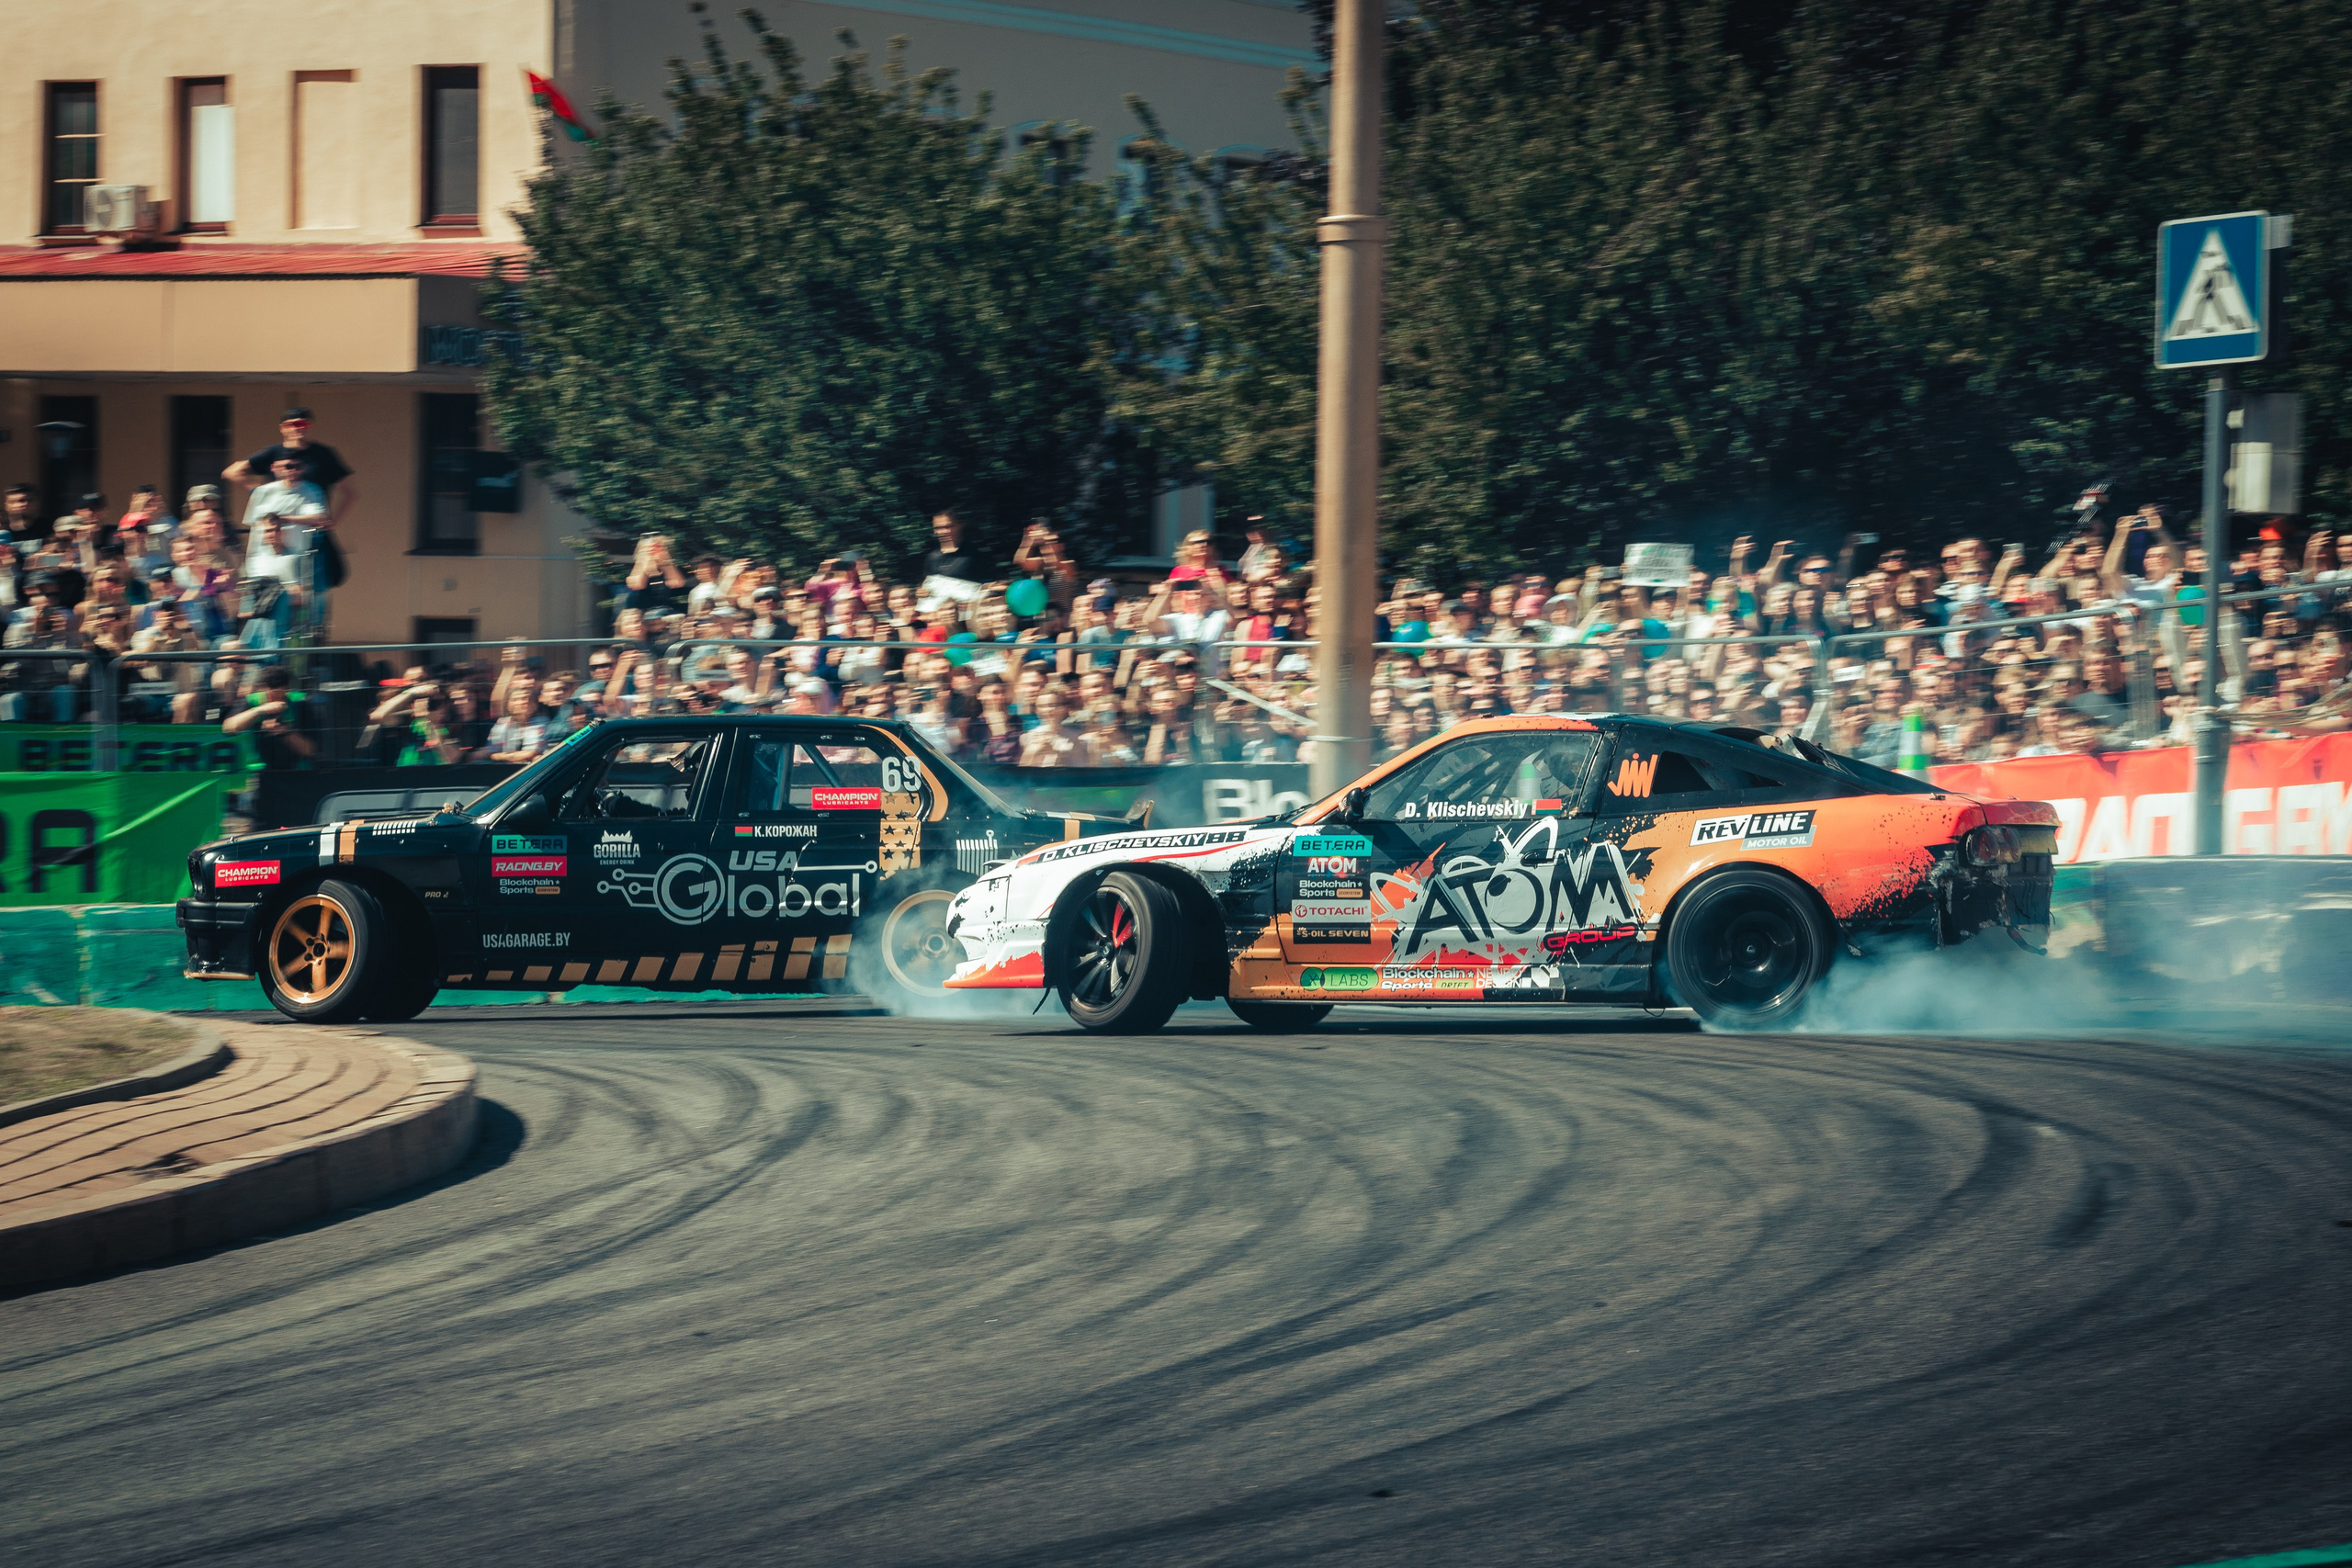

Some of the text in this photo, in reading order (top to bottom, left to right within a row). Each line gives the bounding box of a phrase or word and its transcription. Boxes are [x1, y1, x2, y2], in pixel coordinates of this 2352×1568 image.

[882, 755, 922, 793] 69
[814, 793, 878, 802] CHAMPION
[1405, 800, 1528, 818] D. Klischevskiy
[1062, 832, 1205, 859] KLISCHEVSKIY
[1747, 835, 1808, 849] MOTOR OIL
[594, 843, 641, 858] GORILLA
[495, 862, 563, 872] RACING.BY
[729, 850, 797, 872] USA
[1307, 857, 1357, 874] ATOM
[218, 866, 278, 878] CHAMPION
[499, 878, 554, 886] Blockchain
[1299, 879, 1357, 889] Blockchain
[499, 886, 534, 895] Sports
[660, 862, 860, 919] Global
[1299, 888, 1336, 898] Sports
[1308, 907, 1365, 916] TOTACHI
[482, 932, 571, 948] USAGARAGE.BY
[1328, 930, 1370, 938] SEVEN
[1546, 925, 1636, 949] GROUP
[1382, 968, 1465, 979] Blockchain
[1330, 974, 1370, 987] LABS
